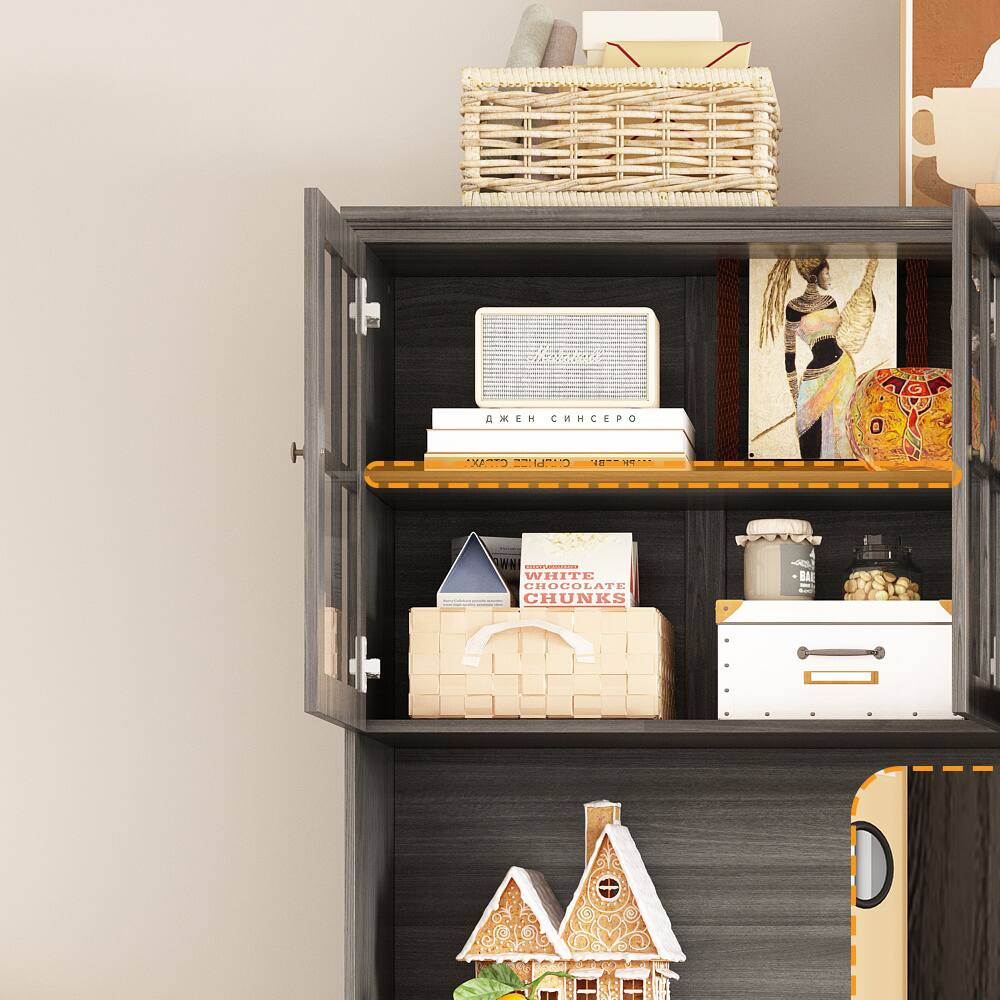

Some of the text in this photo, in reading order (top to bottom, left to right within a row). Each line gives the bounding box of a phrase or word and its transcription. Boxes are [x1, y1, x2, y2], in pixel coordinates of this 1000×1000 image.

[485, 414, 636, 425] ДЖЕН СИНСЕРО
[524, 571, 594, 581] WHITE
[523, 582, 626, 590] CHOCOLATE
[523, 592, 626, 604] CHUNKS
